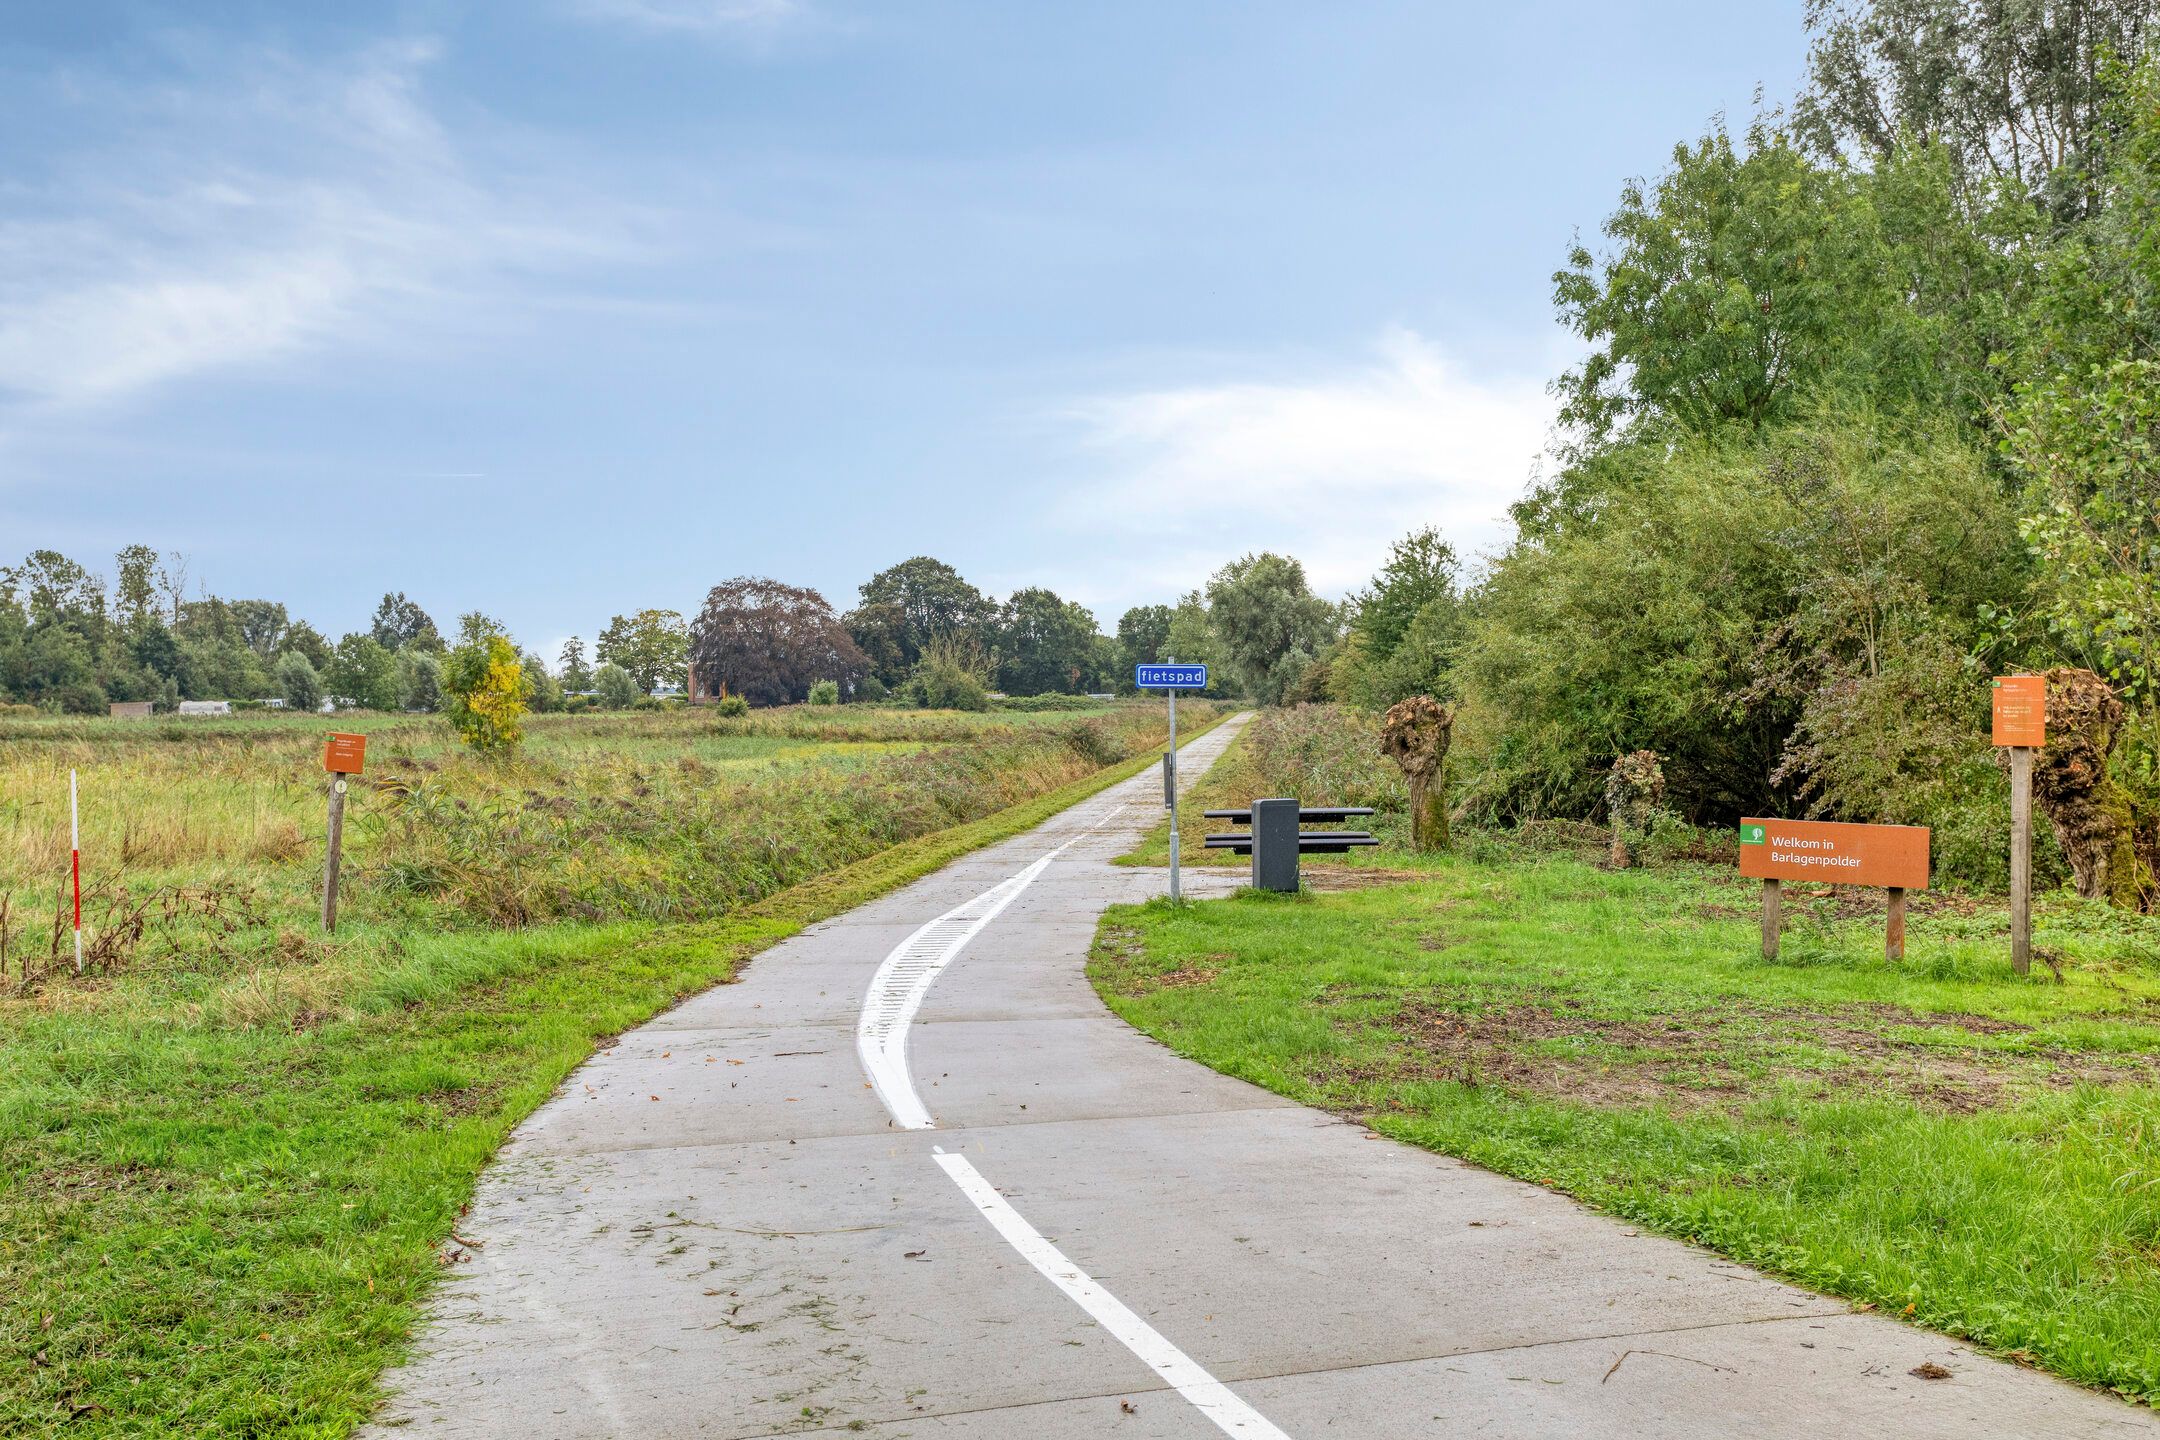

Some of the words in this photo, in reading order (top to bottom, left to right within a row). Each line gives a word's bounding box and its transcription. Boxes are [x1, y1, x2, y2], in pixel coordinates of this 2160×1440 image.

[1141, 671, 1202, 683] fietspad
[1771, 836, 1820, 849] Welkom
[1823, 839, 1834, 850] in
[1771, 852, 1862, 867] Barlagenpolder
